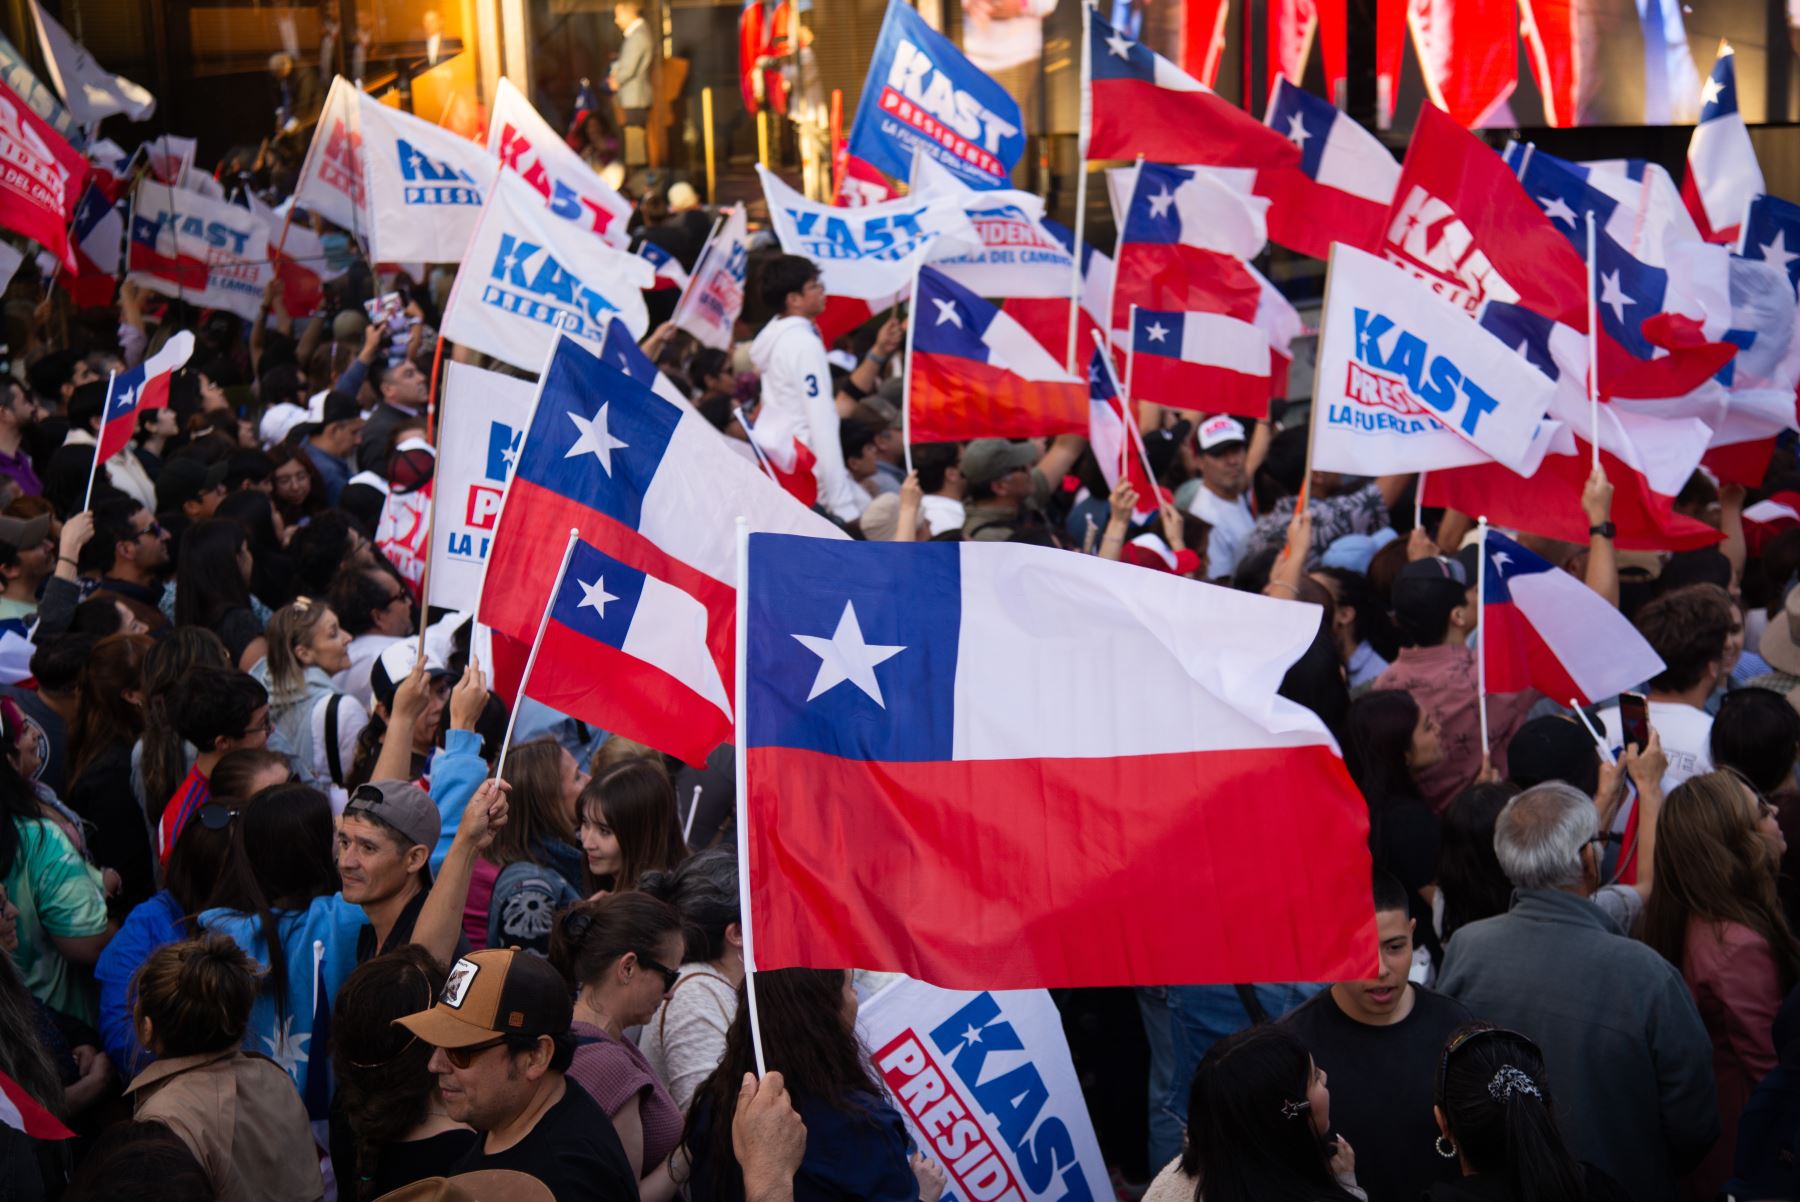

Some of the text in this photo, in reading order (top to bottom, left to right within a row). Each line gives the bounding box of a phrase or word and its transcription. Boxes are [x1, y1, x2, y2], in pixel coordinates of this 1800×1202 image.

[887, 40, 1019, 155] KAST
[881, 90, 1003, 175] PRESIDENTE
[804, 374, 819, 397] 3
[1354, 307, 1500, 437] KAST
[1329, 404, 1352, 425] LA
[448, 532, 472, 557] LA
